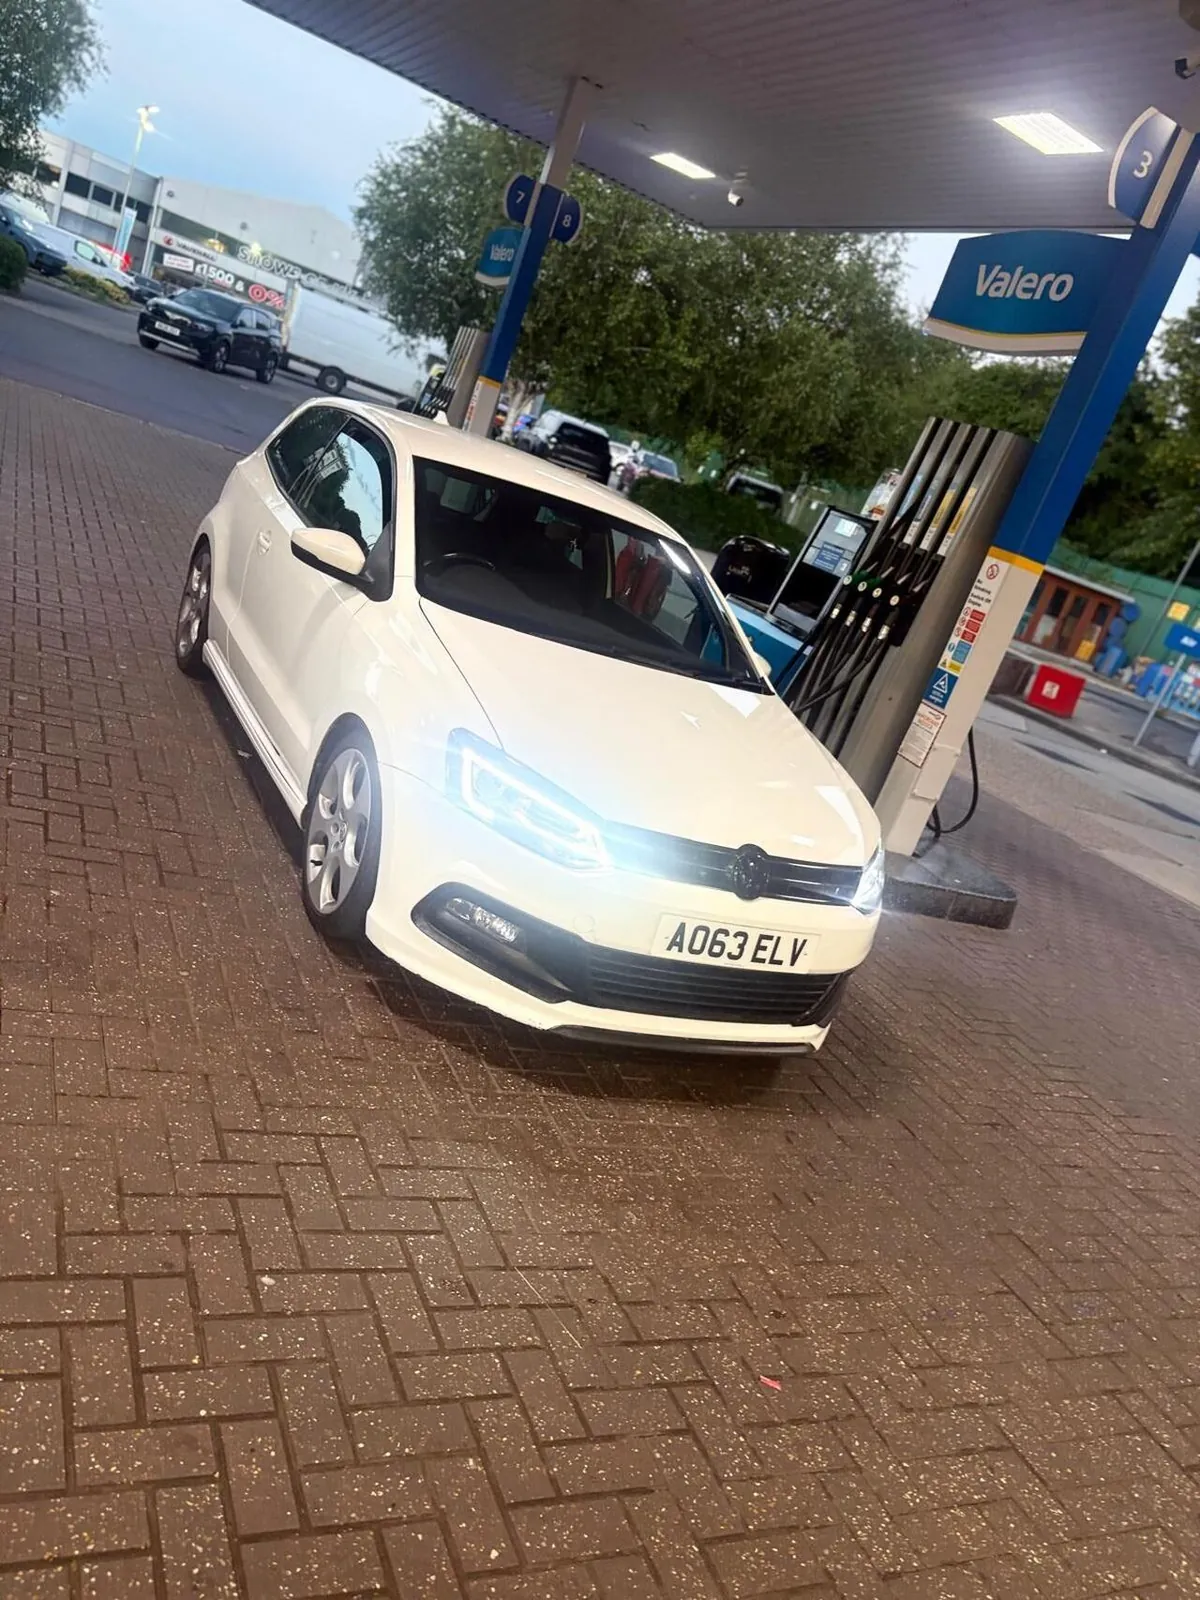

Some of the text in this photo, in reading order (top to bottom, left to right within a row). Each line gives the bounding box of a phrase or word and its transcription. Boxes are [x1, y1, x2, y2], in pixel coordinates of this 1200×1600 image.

[1133, 150, 1153, 178] 3
[516, 191, 525, 204] 7
[562, 214, 572, 227] 8
[976, 264, 1073, 301] Valero
[666, 922, 807, 967] AO63 ELV
